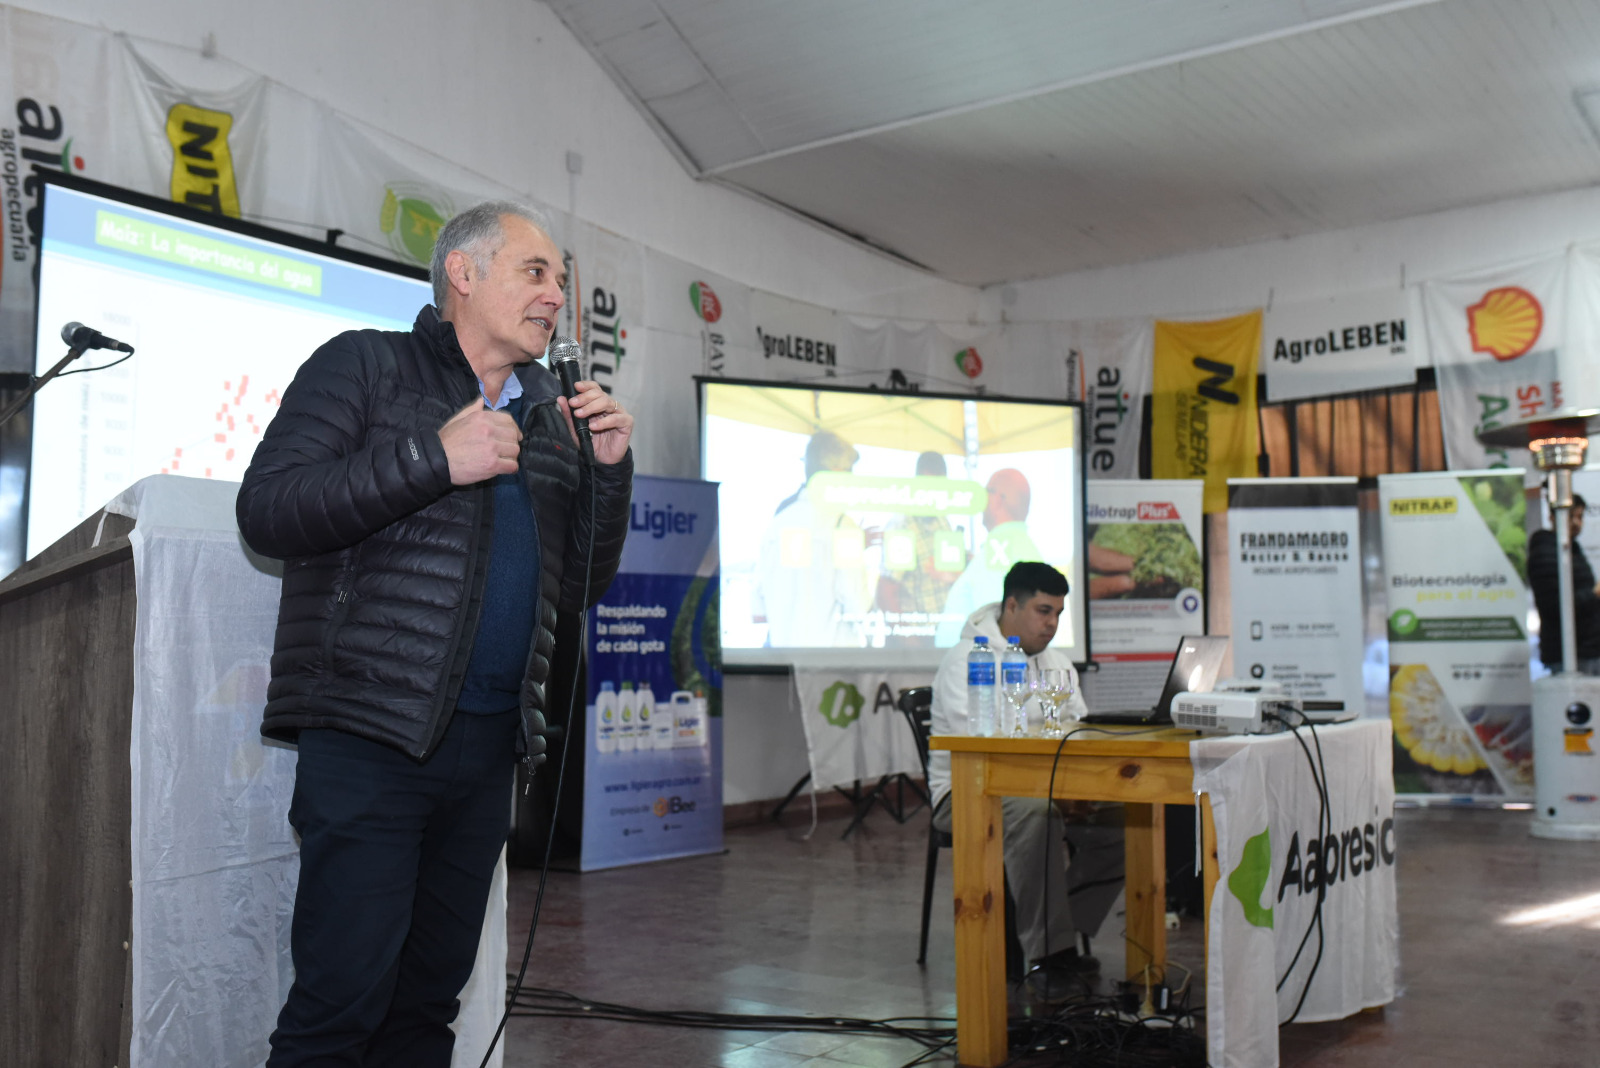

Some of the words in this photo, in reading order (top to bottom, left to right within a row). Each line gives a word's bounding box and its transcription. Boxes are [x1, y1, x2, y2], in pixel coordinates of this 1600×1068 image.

[1, 128, 30, 262] agropecuaria
[151, 232, 170, 254] La
[175, 238, 256, 276] importancia
[259, 260, 280, 280] del
[283, 268, 313, 290] agua
[591, 287, 627, 396] aitu
[1273, 319, 1407, 362] AgroLEBEN
[1092, 367, 1129, 472] aitue
[1086, 504, 1137, 519] ilotrap
[1392, 501, 1454, 512] NITRAP
[630, 502, 698, 539] Ligier
[1240, 531, 1349, 548] FRANDAMAGRO
[1417, 590, 1453, 603] para
[1478, 589, 1516, 603] agro
[597, 604, 667, 619] Respaldando
[597, 622, 607, 635] la
[596, 639, 611, 653] de
[613, 639, 638, 653] cada
[639, 640, 665, 655] gota
